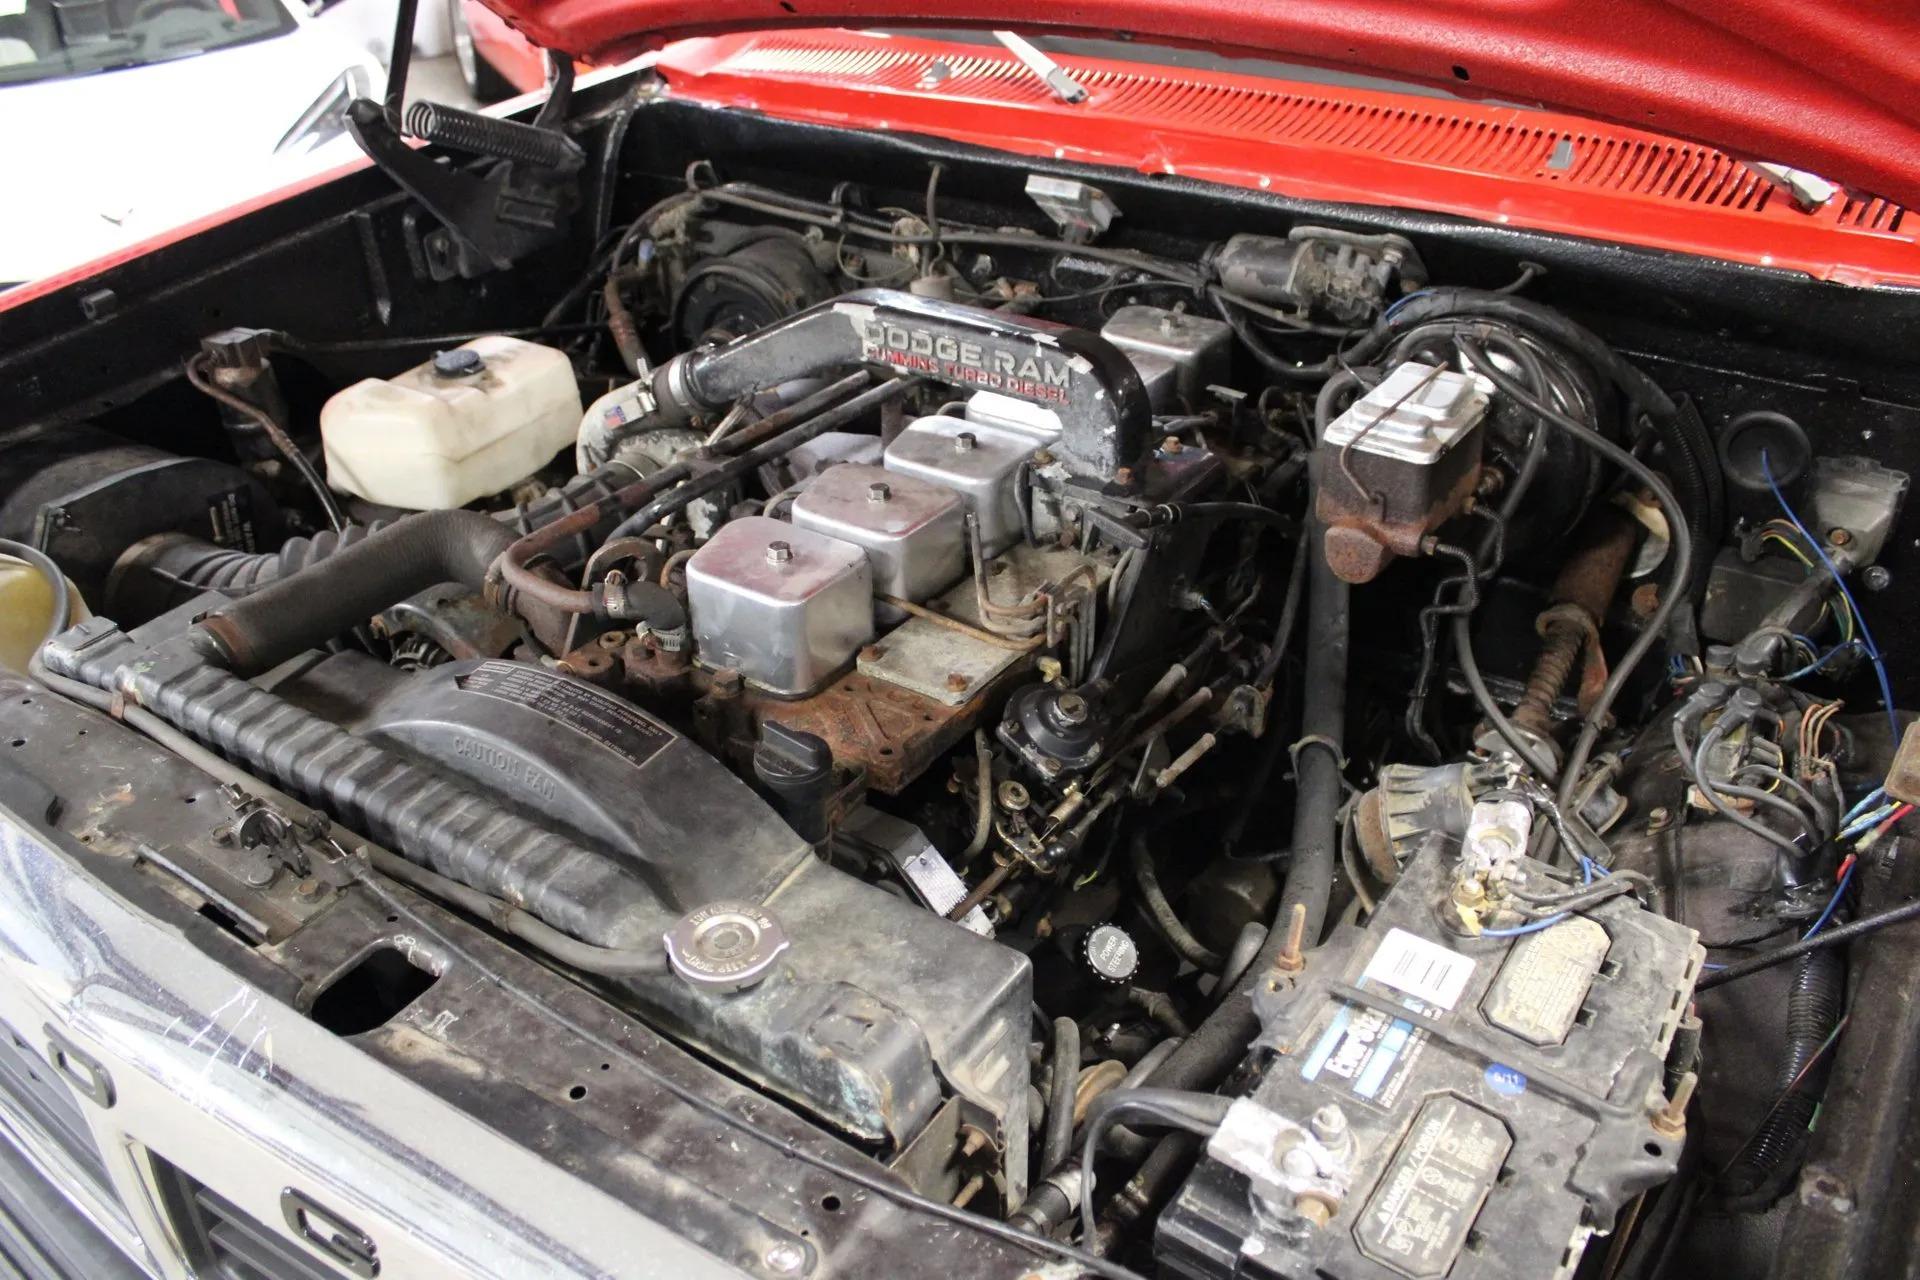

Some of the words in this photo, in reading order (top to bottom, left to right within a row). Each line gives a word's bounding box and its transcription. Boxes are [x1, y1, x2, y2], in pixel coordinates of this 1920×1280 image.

[865, 323, 983, 368] DODGE
[994, 349, 1072, 388] RAM
[866, 345, 939, 374] CUMMINS
[944, 361, 1002, 388] TURBO
[1006, 376, 1071, 405] DIESEL
[453, 735, 520, 779] CAUTION
[523, 765, 557, 801] FAN
[1100, 935, 1118, 962] POWER
[1107, 939, 1130, 973] STEERING
[1382, 1165, 1416, 1213] DANGER
[1411, 1118, 1441, 1160] POISON
